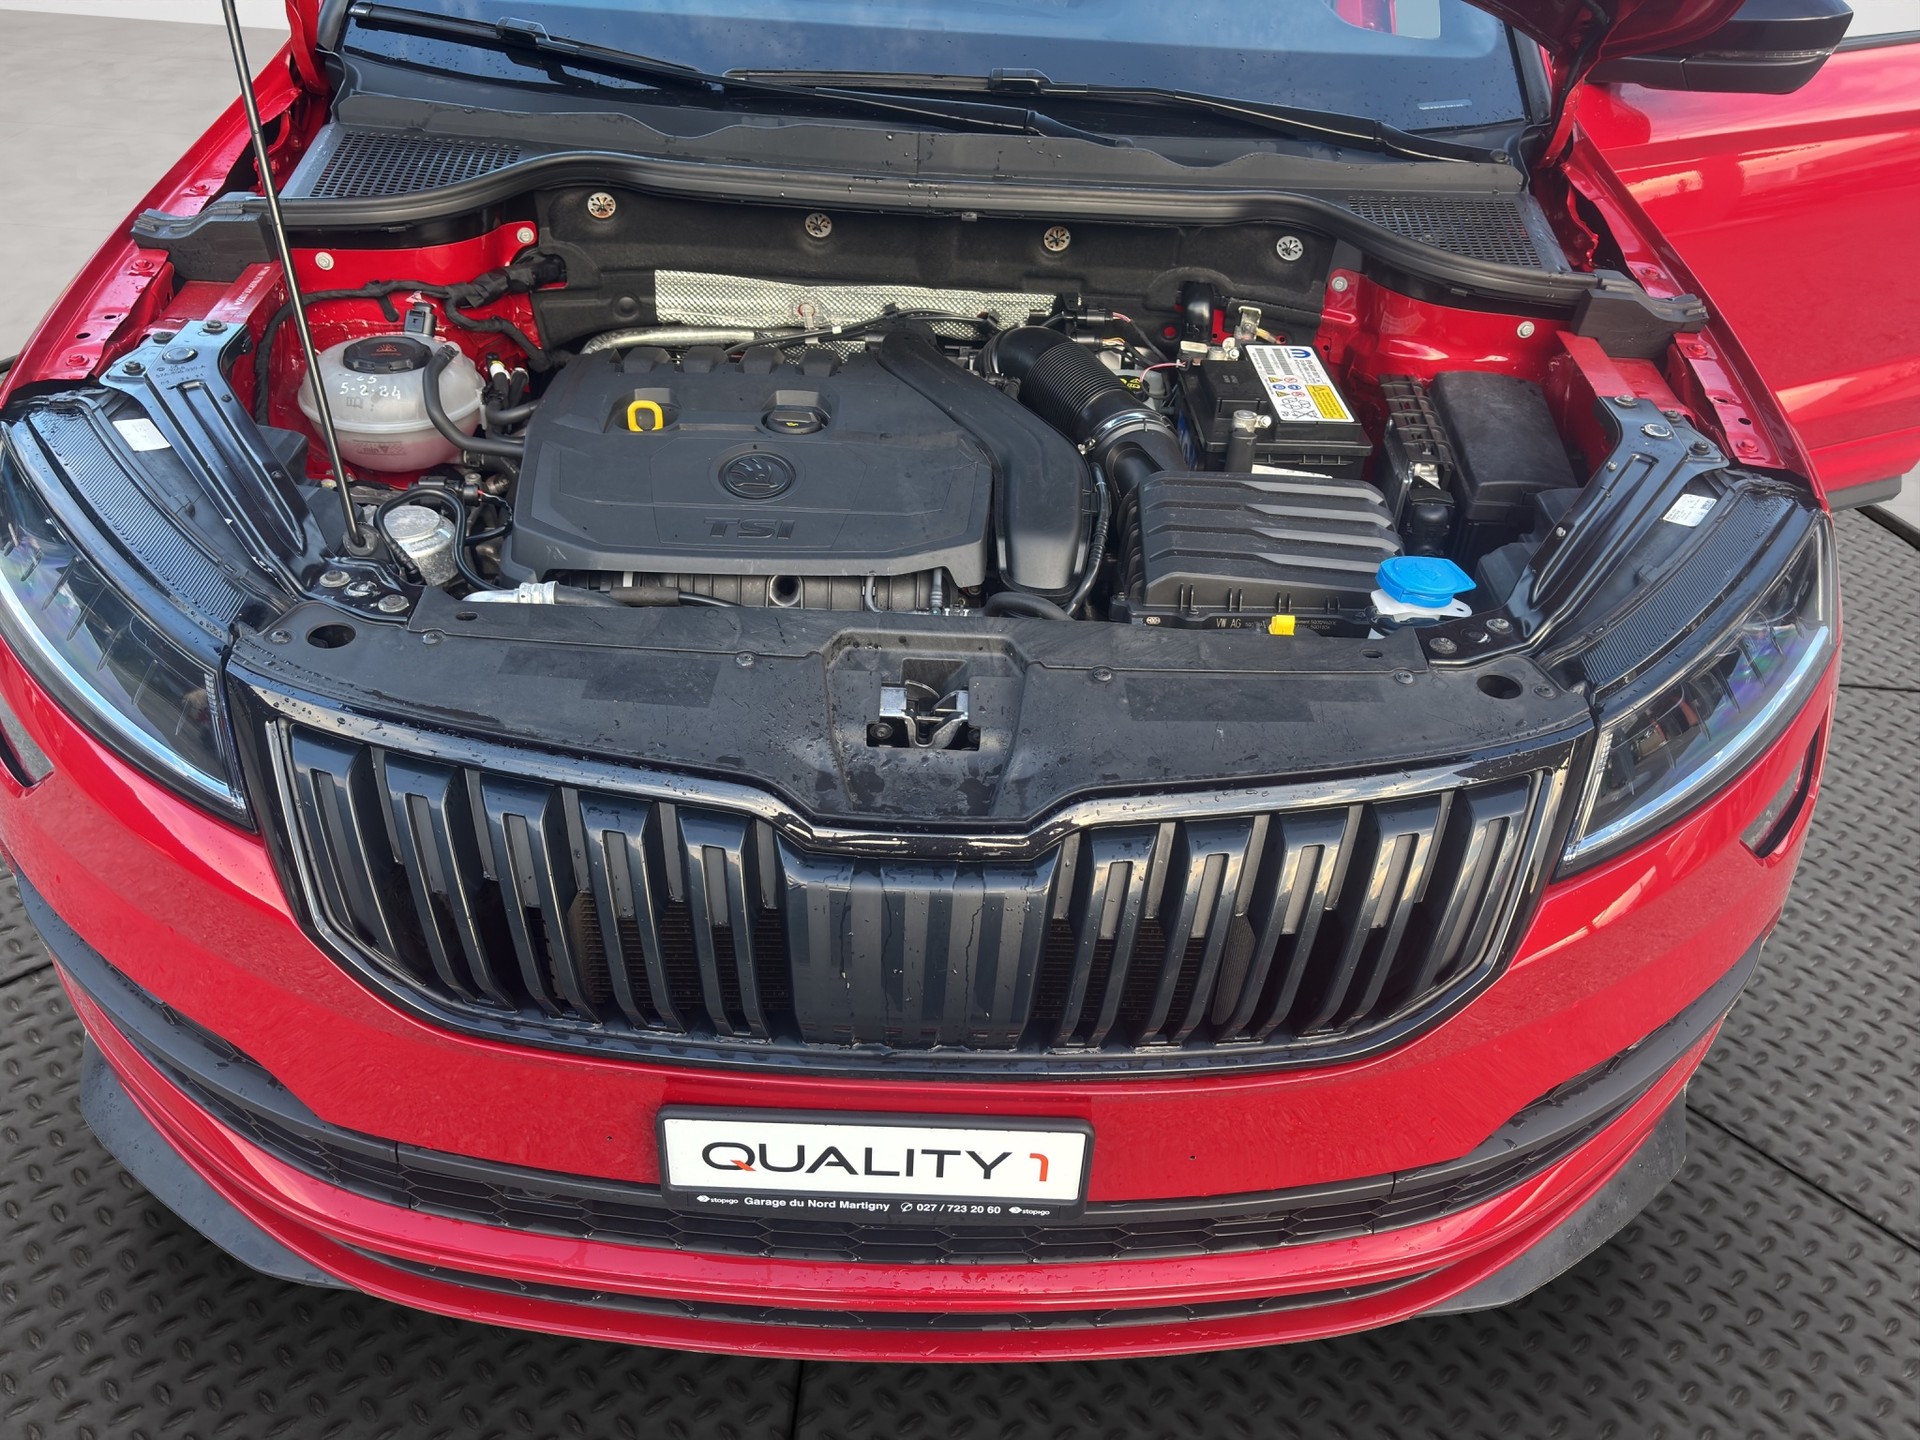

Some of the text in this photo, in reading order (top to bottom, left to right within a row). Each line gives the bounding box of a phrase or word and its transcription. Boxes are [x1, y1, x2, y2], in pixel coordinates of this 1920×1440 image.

[703, 516, 795, 540] TSI
[1216, 617, 1228, 627] VW
[1230, 618, 1242, 629] AG
[702, 1141, 1049, 1182] QUALITY 1
[744, 1196, 890, 1211] Garage du Nord Martigny
[916, 1203, 937, 1212] 027
[947, 1204, 967, 1213] 723
[970, 1205, 984, 1214] 20
[987, 1205, 1001, 1214] 60
